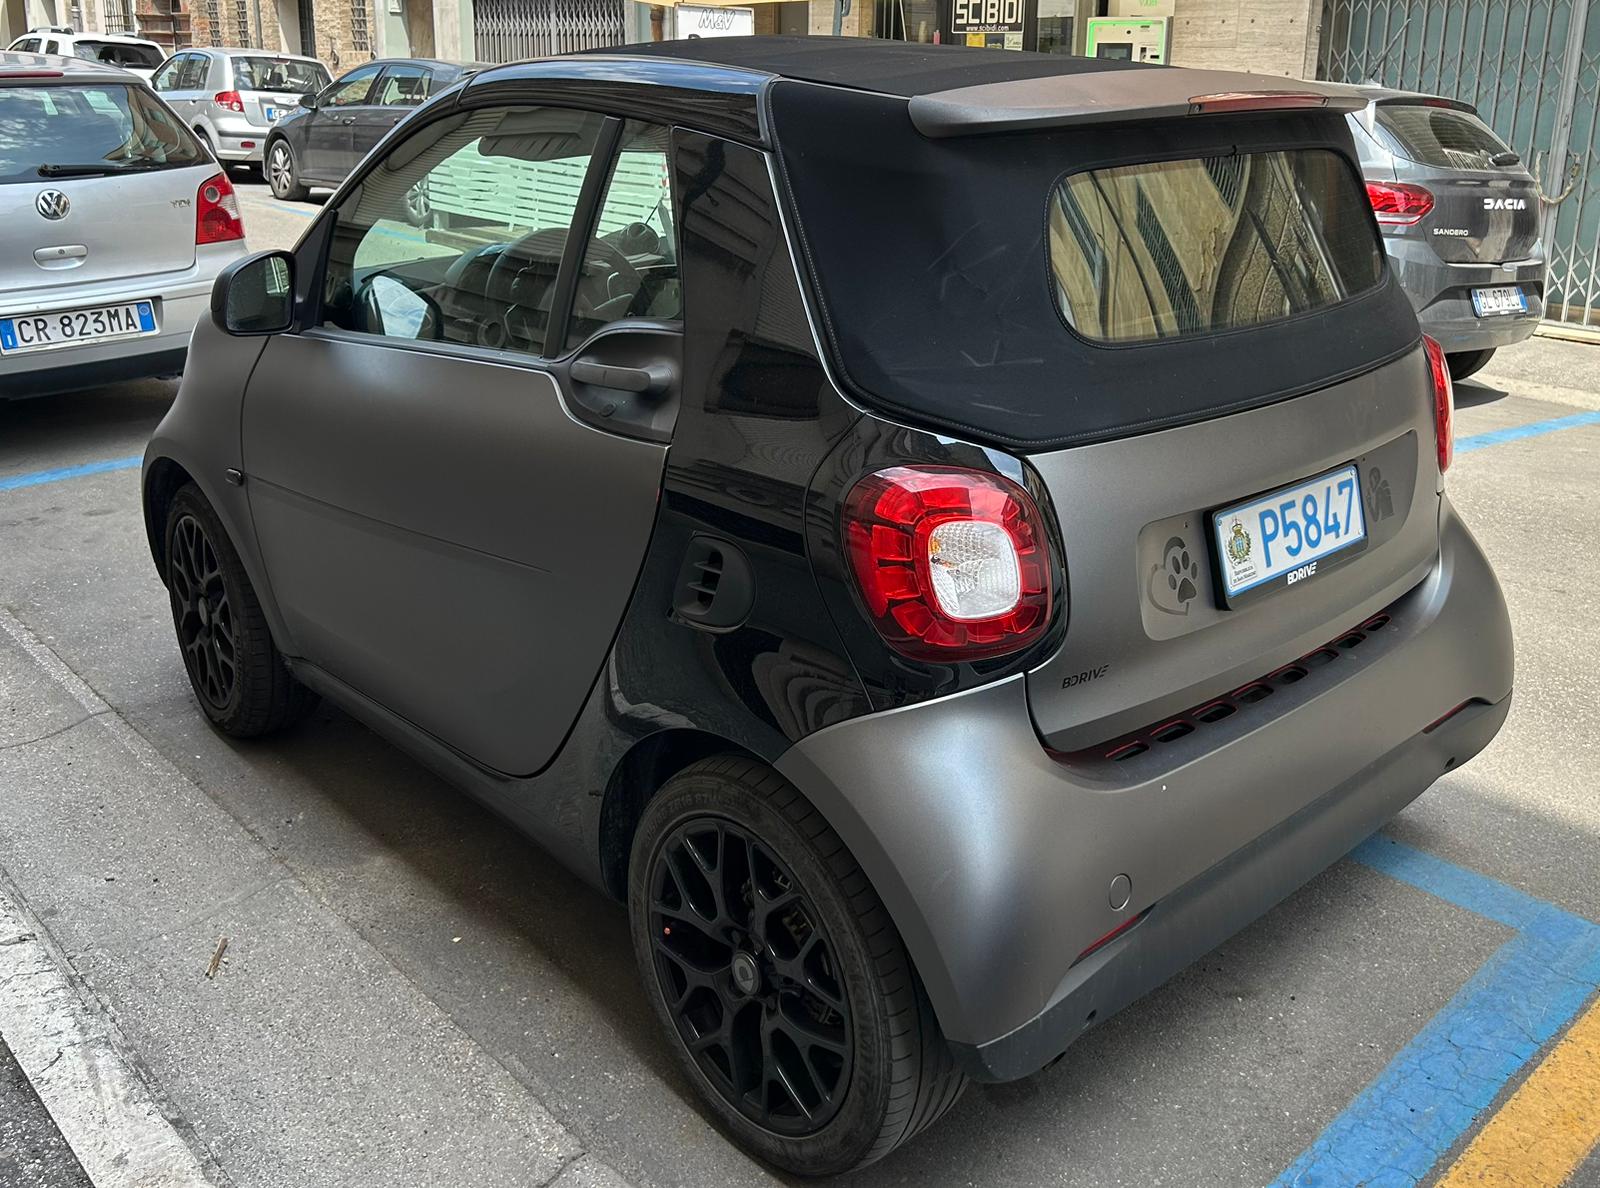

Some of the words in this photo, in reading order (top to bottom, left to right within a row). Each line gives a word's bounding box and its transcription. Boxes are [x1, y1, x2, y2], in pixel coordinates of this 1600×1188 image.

[698, 8, 736, 30] M&V
[955, 0, 1022, 24] SCIBIDI
[1483, 198, 1526, 210] DACIA
[1433, 228, 1469, 236] SANDERO
[17, 319, 51, 344] CR
[59, 308, 138, 338] 823MA
[1259, 479, 1354, 568] P5847
[1287, 561, 1318, 586] BDRIVE
[1062, 664, 1109, 689] BDRIVE
